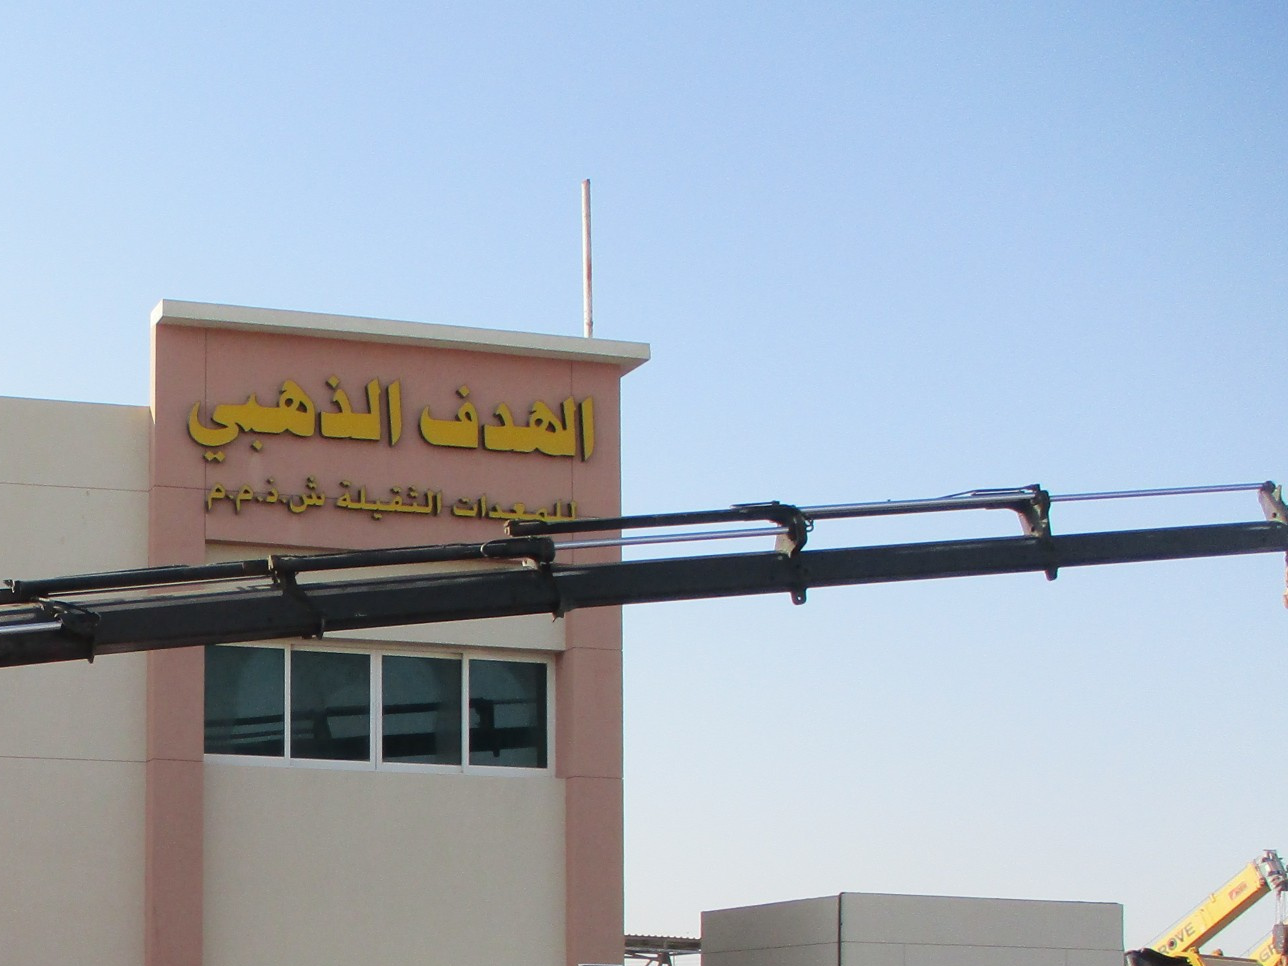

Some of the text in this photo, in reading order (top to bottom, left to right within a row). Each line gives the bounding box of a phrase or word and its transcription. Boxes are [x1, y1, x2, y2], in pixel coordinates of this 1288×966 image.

[188, 374, 594, 463] الهدف الذهبي
[336, 480, 442, 520] الثقيلة
[451, 494, 577, 522] للمعدات
[1158, 922, 1196, 954] ROVE
